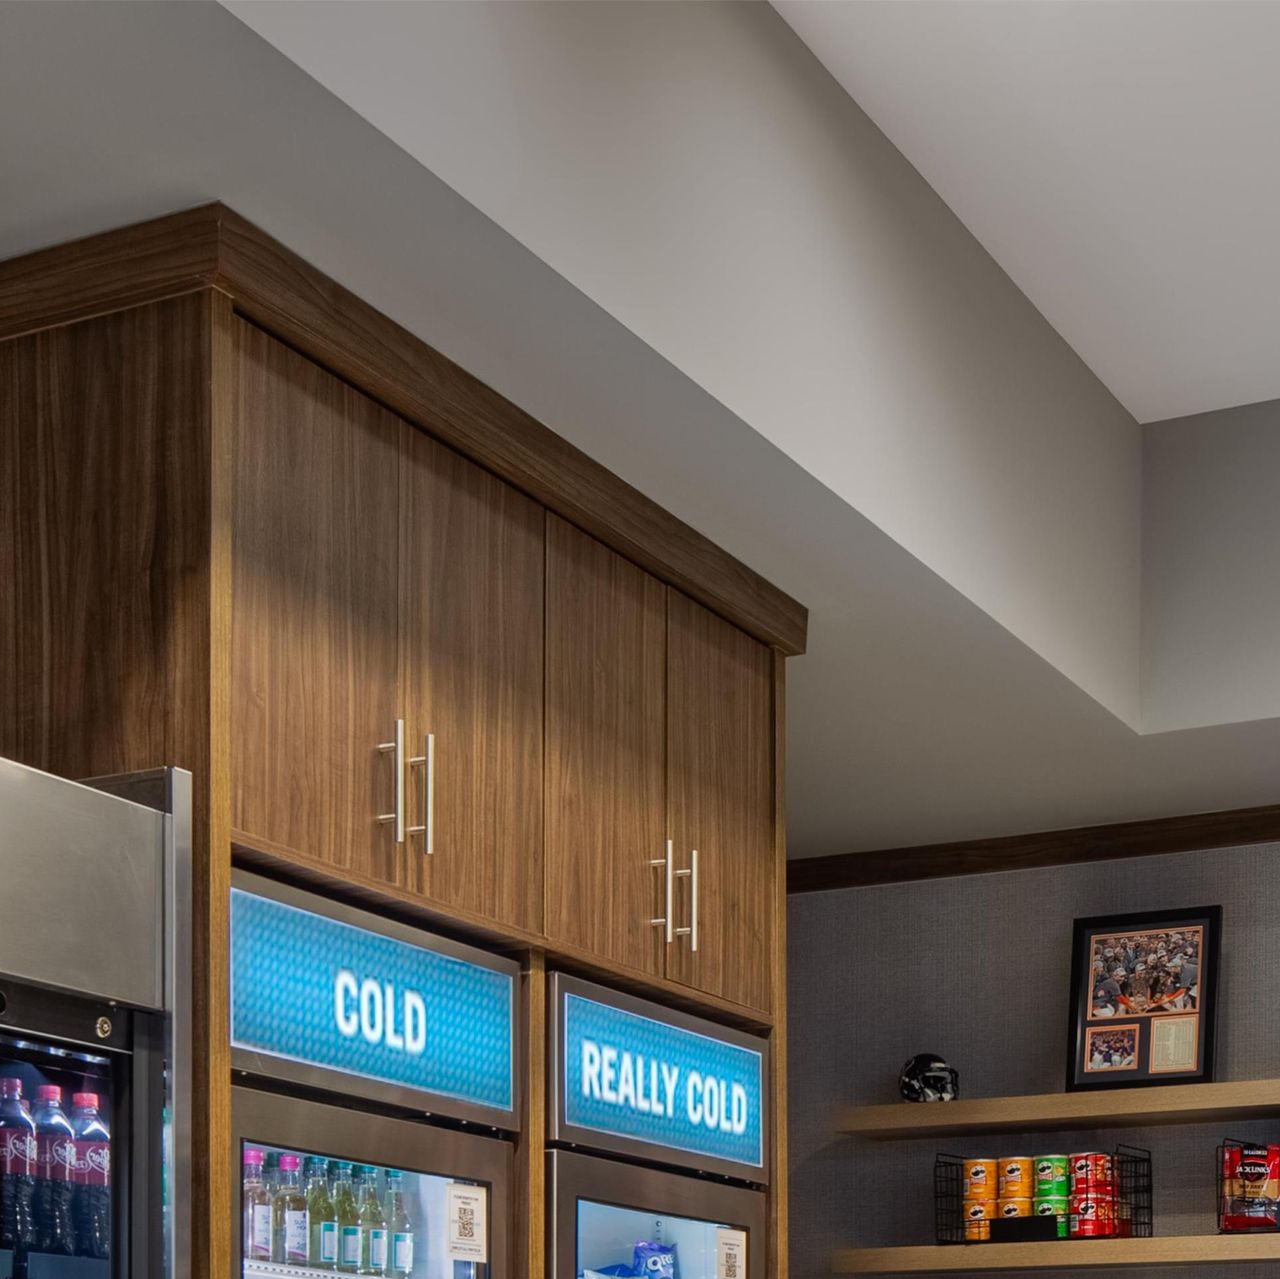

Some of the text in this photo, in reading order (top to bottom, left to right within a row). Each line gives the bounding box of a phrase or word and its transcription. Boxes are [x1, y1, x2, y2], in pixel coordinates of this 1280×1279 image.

[334, 969, 427, 1054] COLD
[580, 1038, 748, 1135] REALLY COLD
